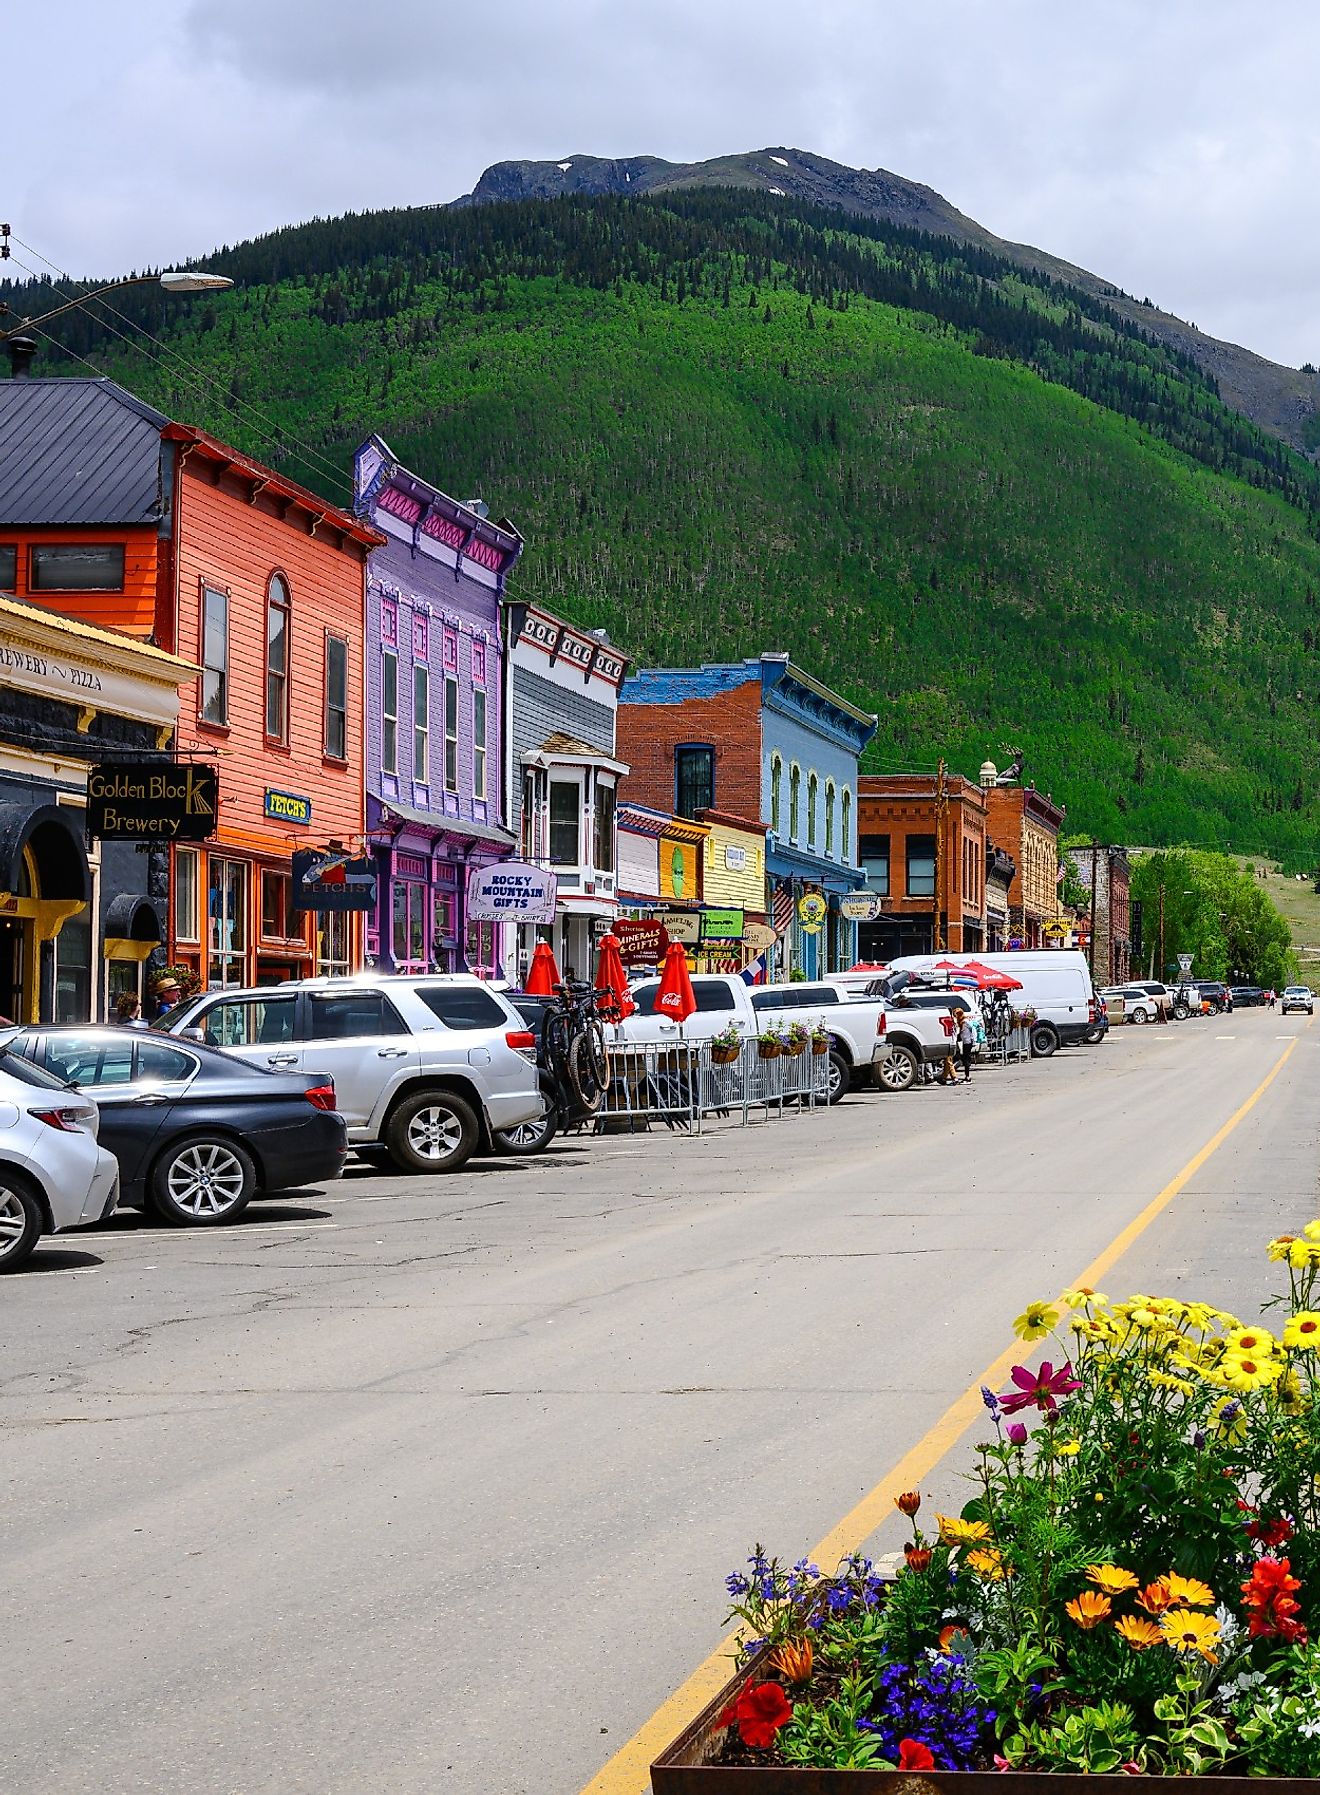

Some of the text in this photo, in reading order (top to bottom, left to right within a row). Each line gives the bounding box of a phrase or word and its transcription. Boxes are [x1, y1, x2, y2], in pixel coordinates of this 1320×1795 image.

[69, 667, 102, 690] PIZZA
[89, 775, 145, 798] Golden
[270, 794, 306, 819] FETCH'S
[103, 807, 180, 835] Brewery
[482, 886, 544, 898] MOUNTAIN
[491, 875, 532, 887] ROCKY
[493, 898, 529, 909] GIFTS
